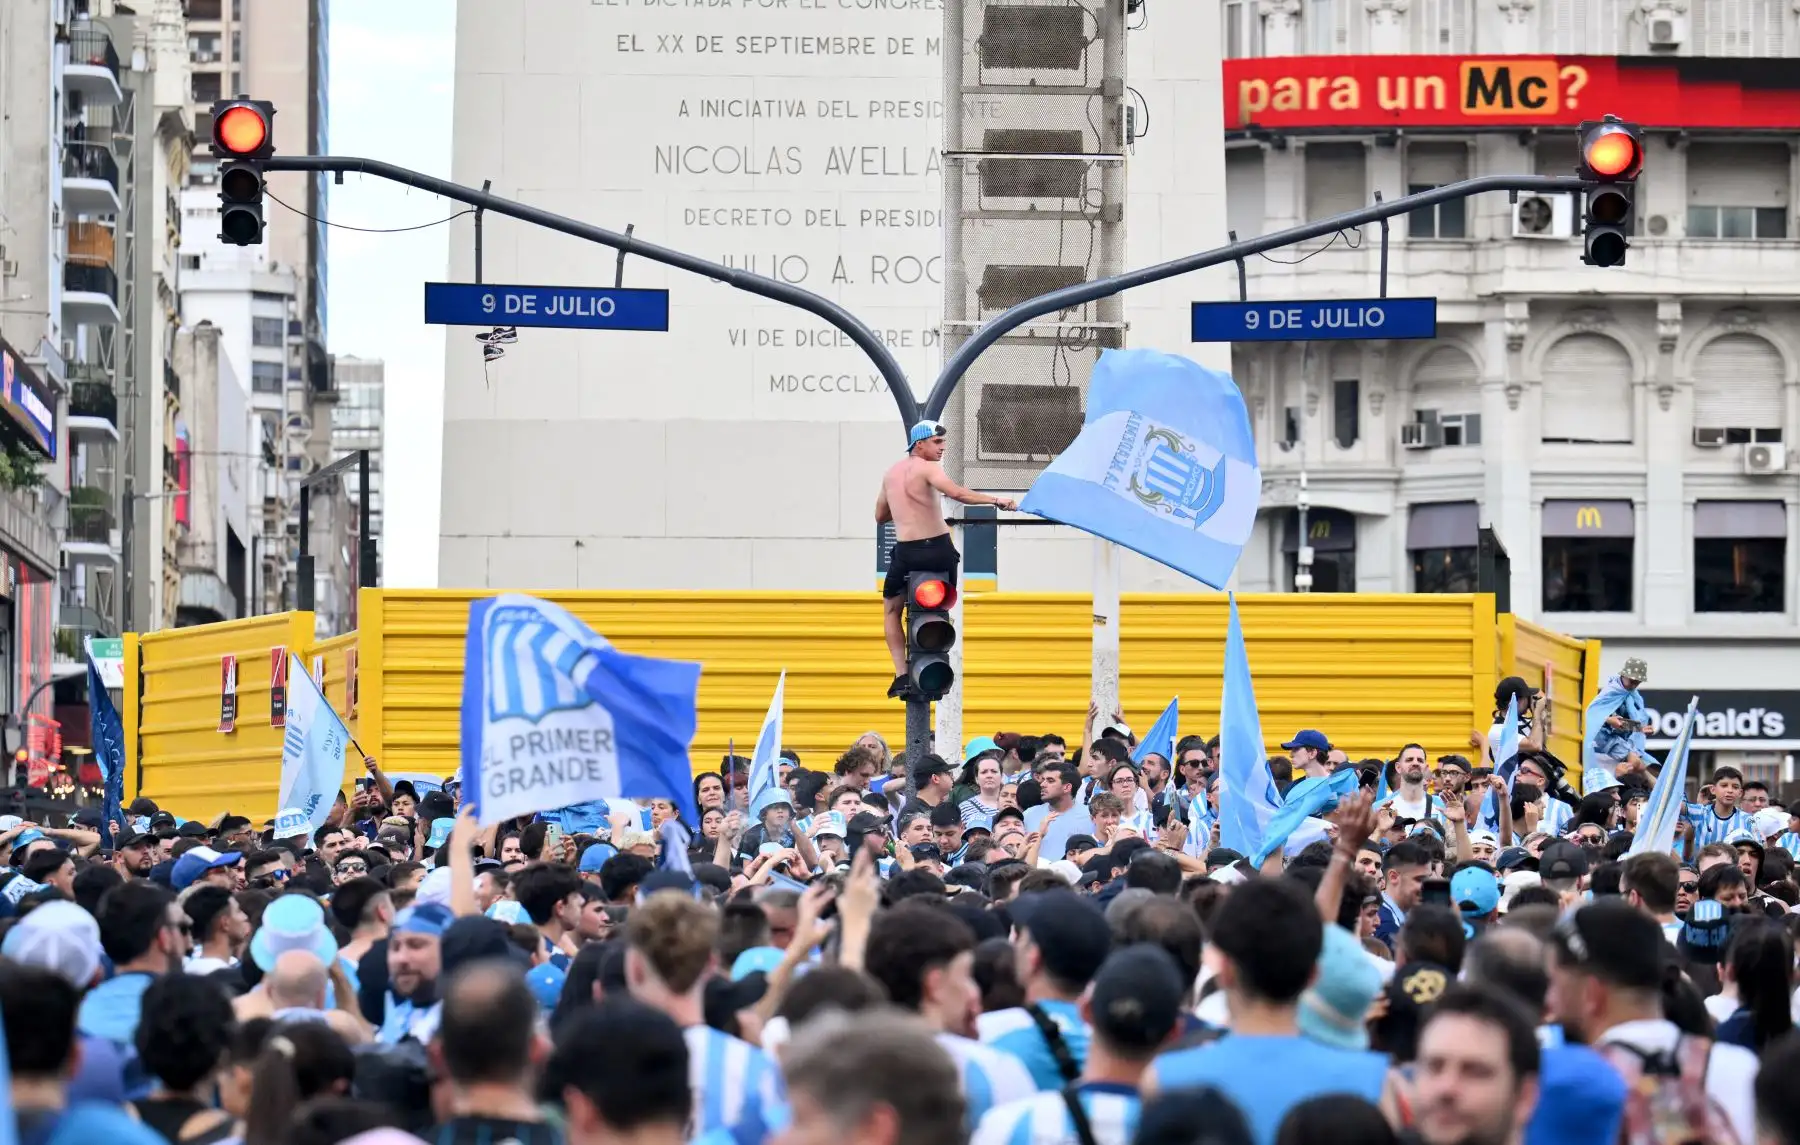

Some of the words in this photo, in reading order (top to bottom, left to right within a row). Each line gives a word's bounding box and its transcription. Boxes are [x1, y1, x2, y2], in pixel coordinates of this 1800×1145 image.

[617, 34, 645, 52] EL
[656, 34, 684, 53] XX
[696, 35, 724, 53] DE
[736, 36, 876, 55] SEPTIEMBRE
[887, 37, 914, 55] DE
[678, 99, 690, 118] A
[700, 99, 807, 118] INICIATIVA
[817, 100, 859, 119] DEL
[1238, 73, 1360, 125] para
[1376, 74, 1446, 110] un
[655, 144, 803, 175] NICOLAS
[684, 208, 792, 226] DECRETO
[805, 209, 847, 227] DEL
[831, 254, 855, 285] A.
[481, 293, 496, 314] 9
[505, 294, 538, 315] DE
[544, 295, 616, 317] JULIO
[1244, 310, 1260, 330] 9
[1269, 309, 1303, 329] DE
[1310, 306, 1386, 329] JULIO
[728, 329, 747, 347] VI
[757, 329, 786, 347] DE
[510, 727, 613, 761] PRIMER
[487, 756, 603, 799] GRANDE
